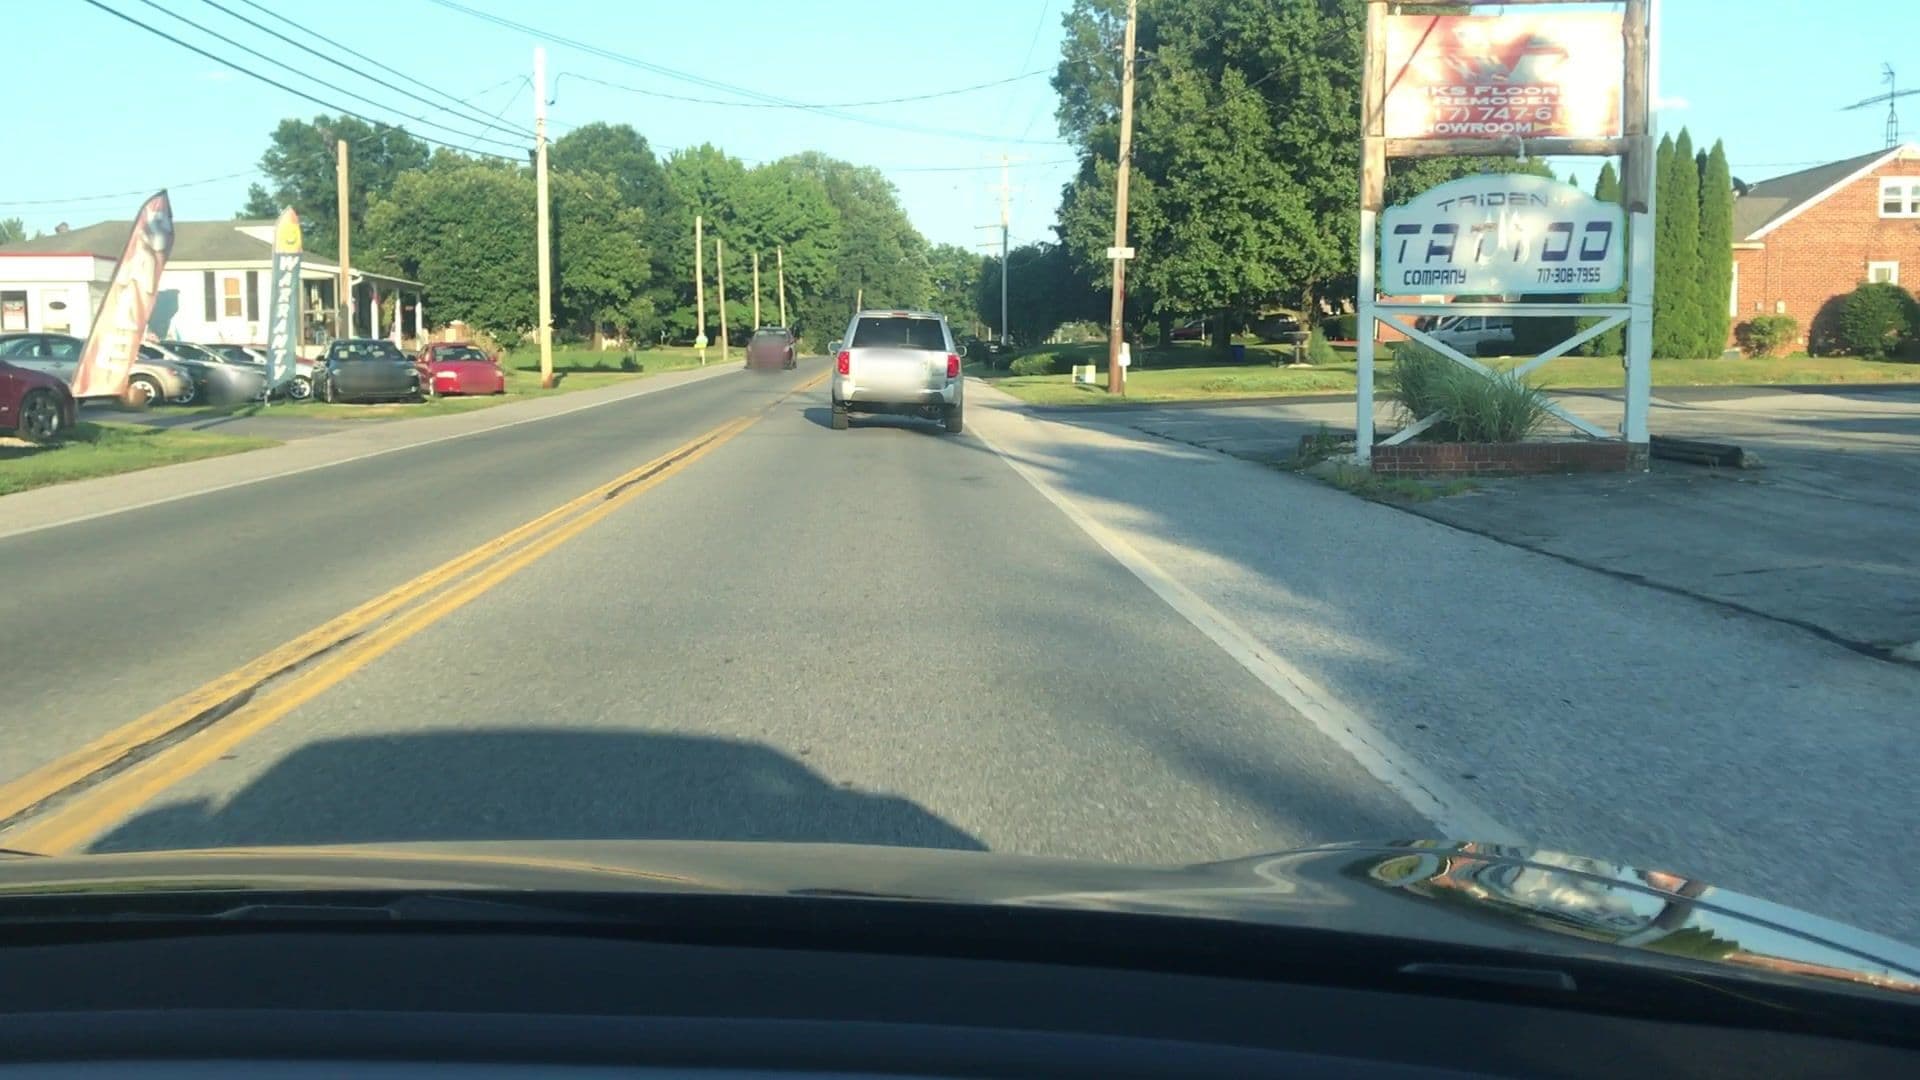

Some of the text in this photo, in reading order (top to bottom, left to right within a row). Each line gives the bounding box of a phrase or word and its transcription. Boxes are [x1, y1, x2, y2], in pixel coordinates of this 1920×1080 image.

[1431, 86, 1558, 95] KS FLOOR
[1435, 97, 1553, 105] REMODEL
[1479, 107, 1552, 120] 747-6
[1404, 269, 1467, 286] COMPANY
[271, 255, 300, 380] WARRANTY
